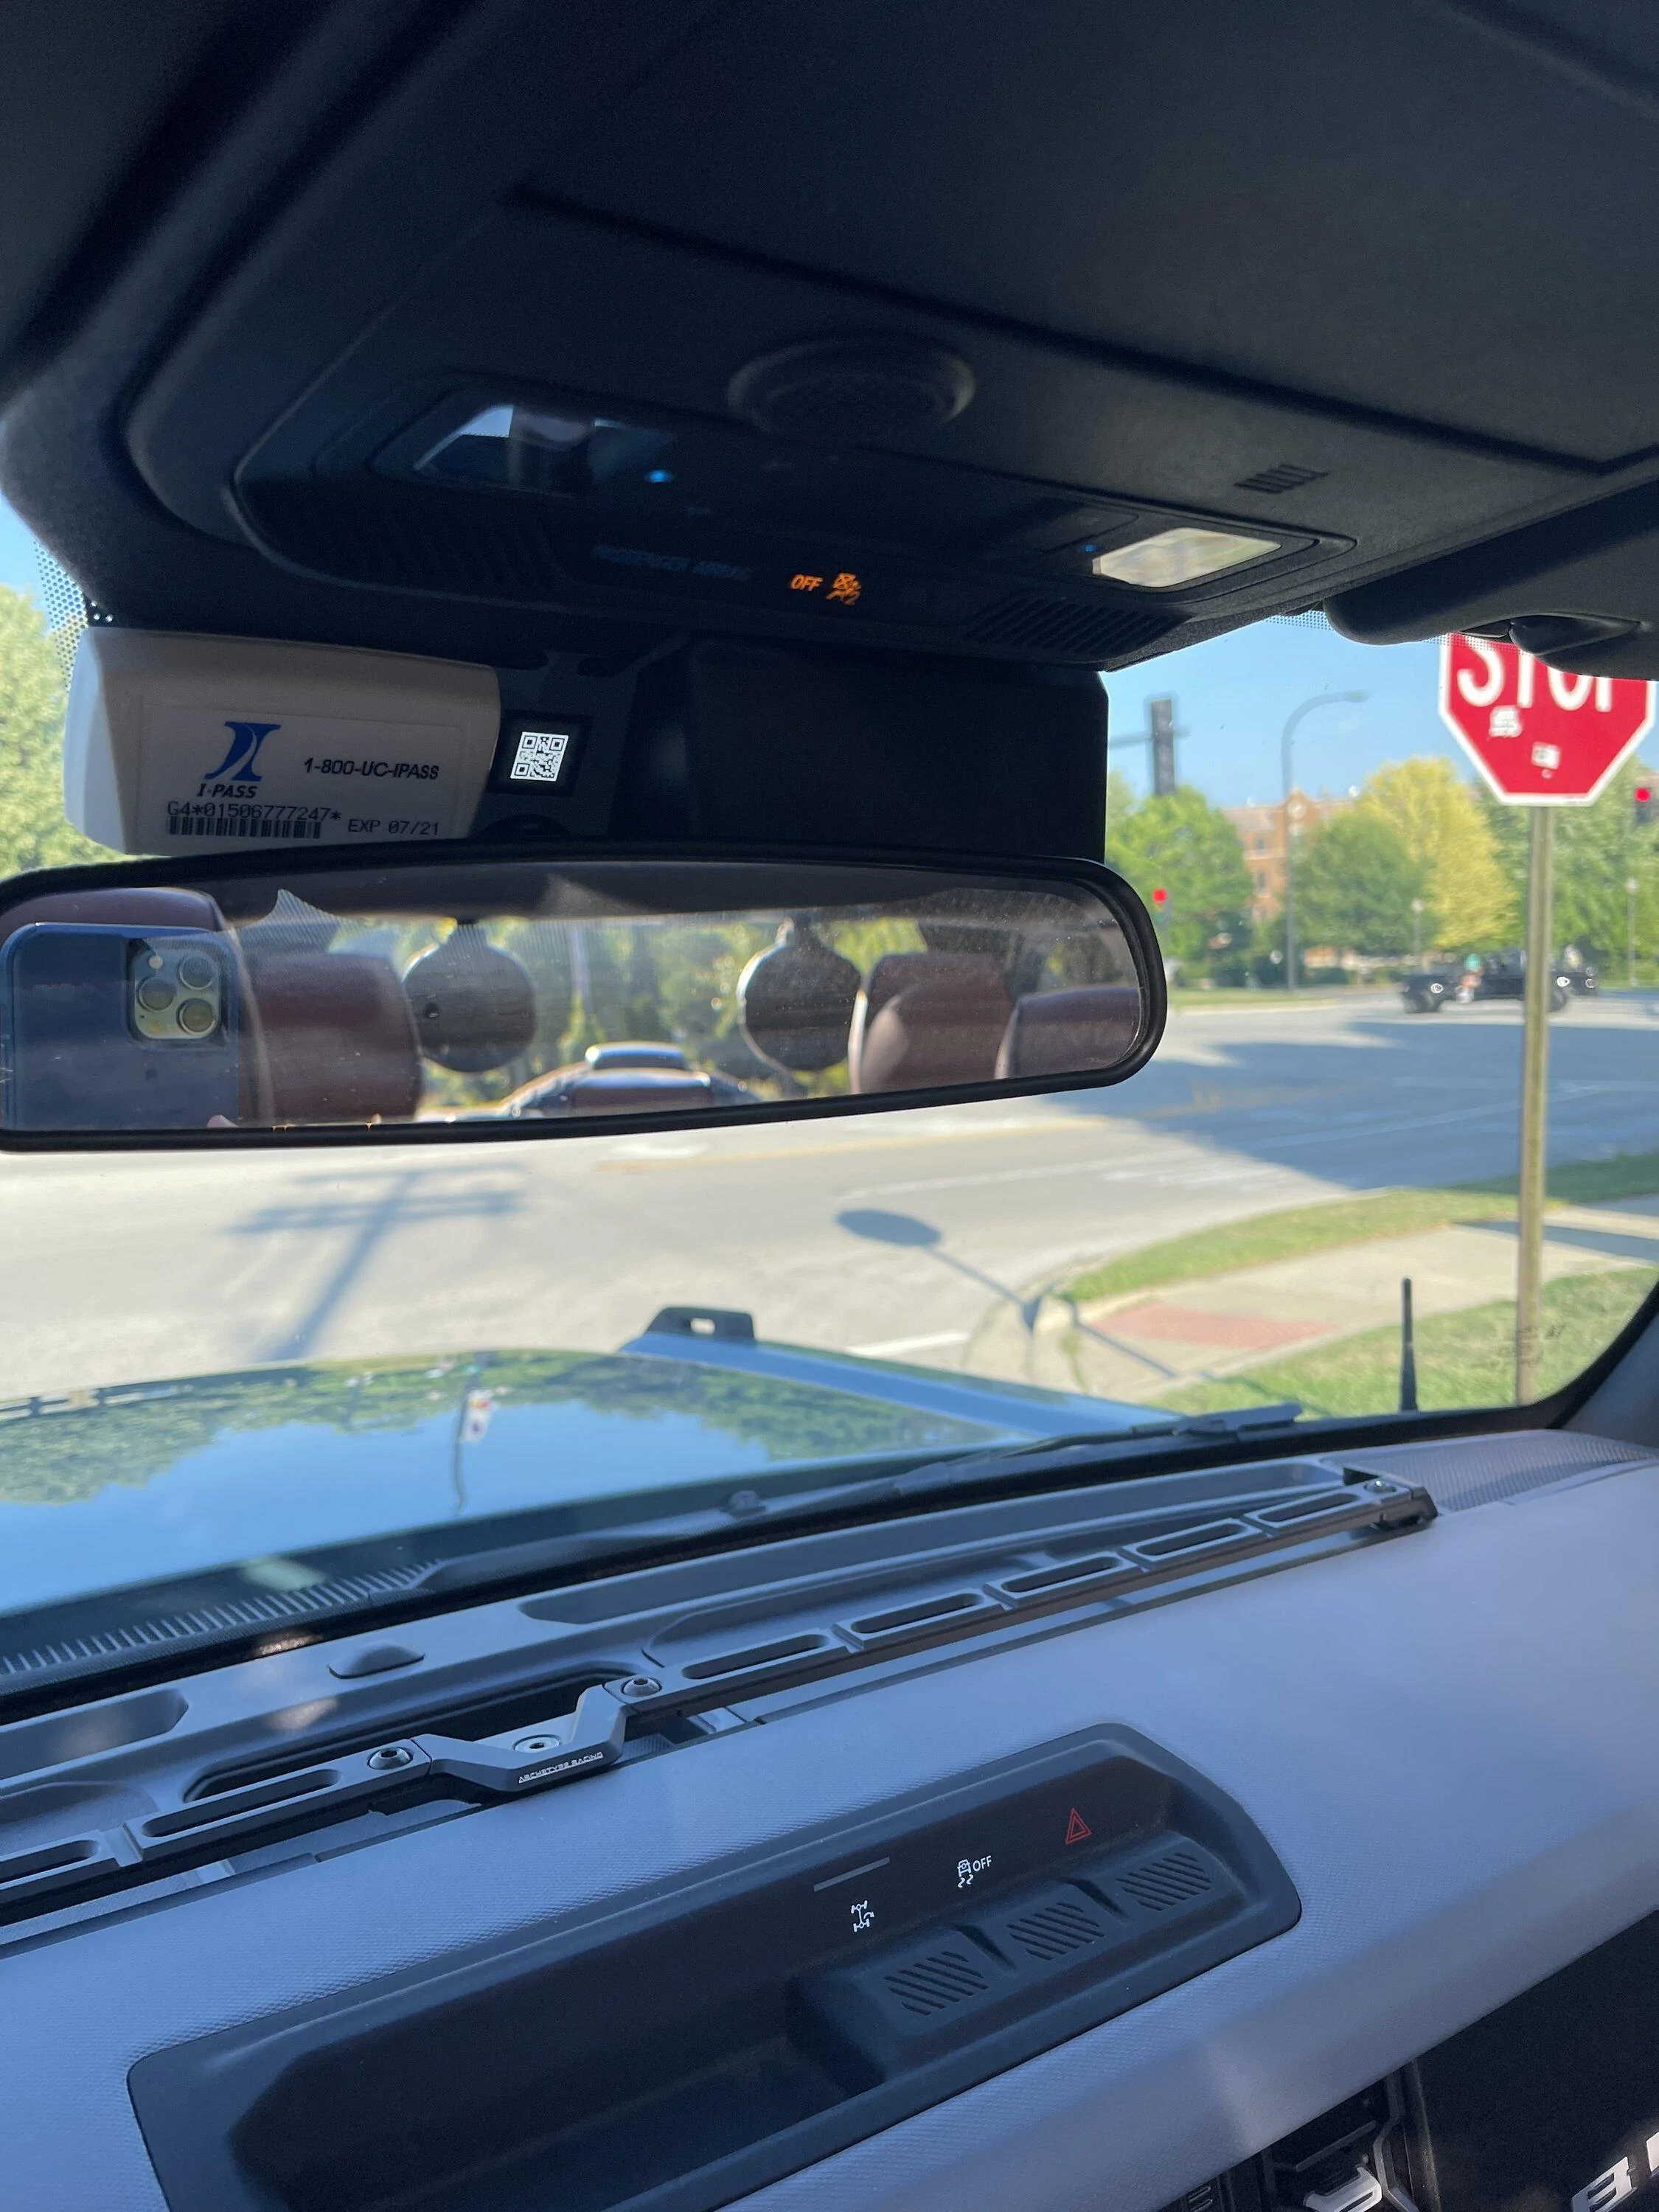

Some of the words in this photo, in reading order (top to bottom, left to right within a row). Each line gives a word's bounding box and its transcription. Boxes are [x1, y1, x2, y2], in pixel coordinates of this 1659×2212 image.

[790, 574, 823, 591] OFF
[304, 757, 440, 780] 1-800-UC-IPASS
[347, 819, 381, 834] EXP
[388, 821, 439, 836] 07/21
[973, 1855, 992, 1872] OFF
